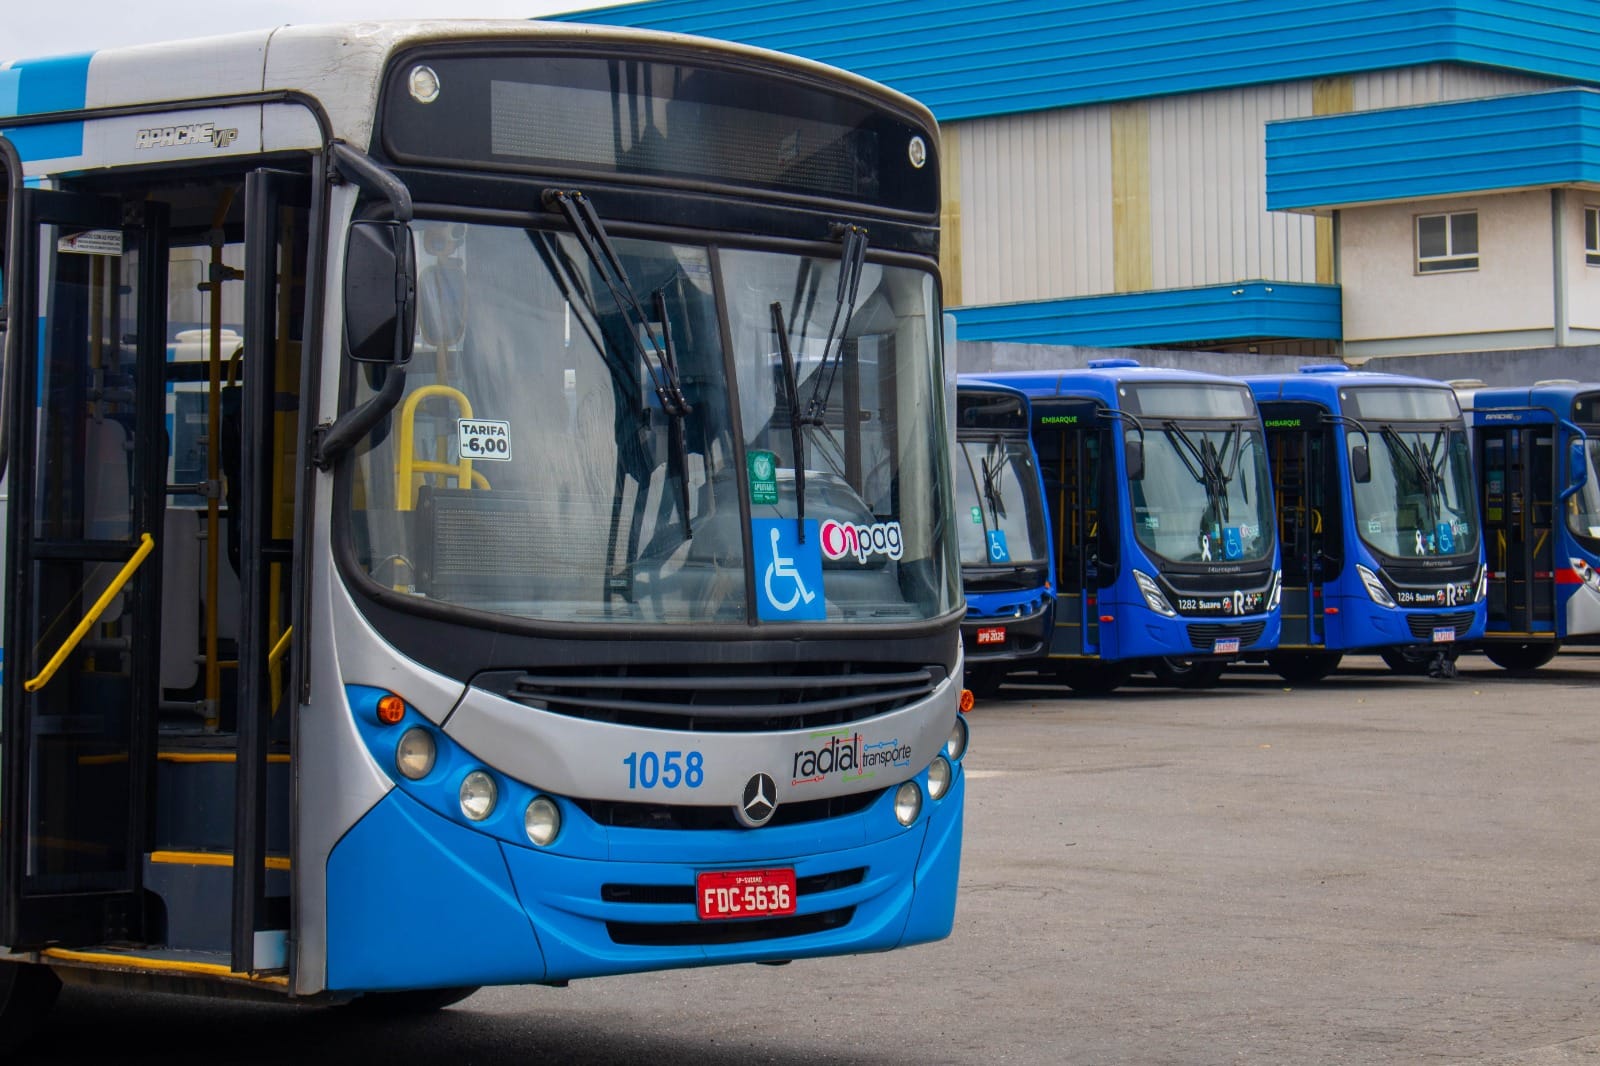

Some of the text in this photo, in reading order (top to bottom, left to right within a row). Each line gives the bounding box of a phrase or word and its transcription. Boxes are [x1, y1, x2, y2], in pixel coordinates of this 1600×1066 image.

[135, 122, 239, 149] APACHE VIP
[1041, 416, 1078, 424] EMBARQUE
[1265, 419, 1301, 427] EMBARQUE
[462, 424, 506, 436] TARIFA
[469, 437, 507, 455] 6,00
[1397, 592, 1414, 602] 1284
[1178, 599, 1197, 610] 1282
[793, 732, 912, 778] radial transporte
[623, 751, 704, 789] 1058
